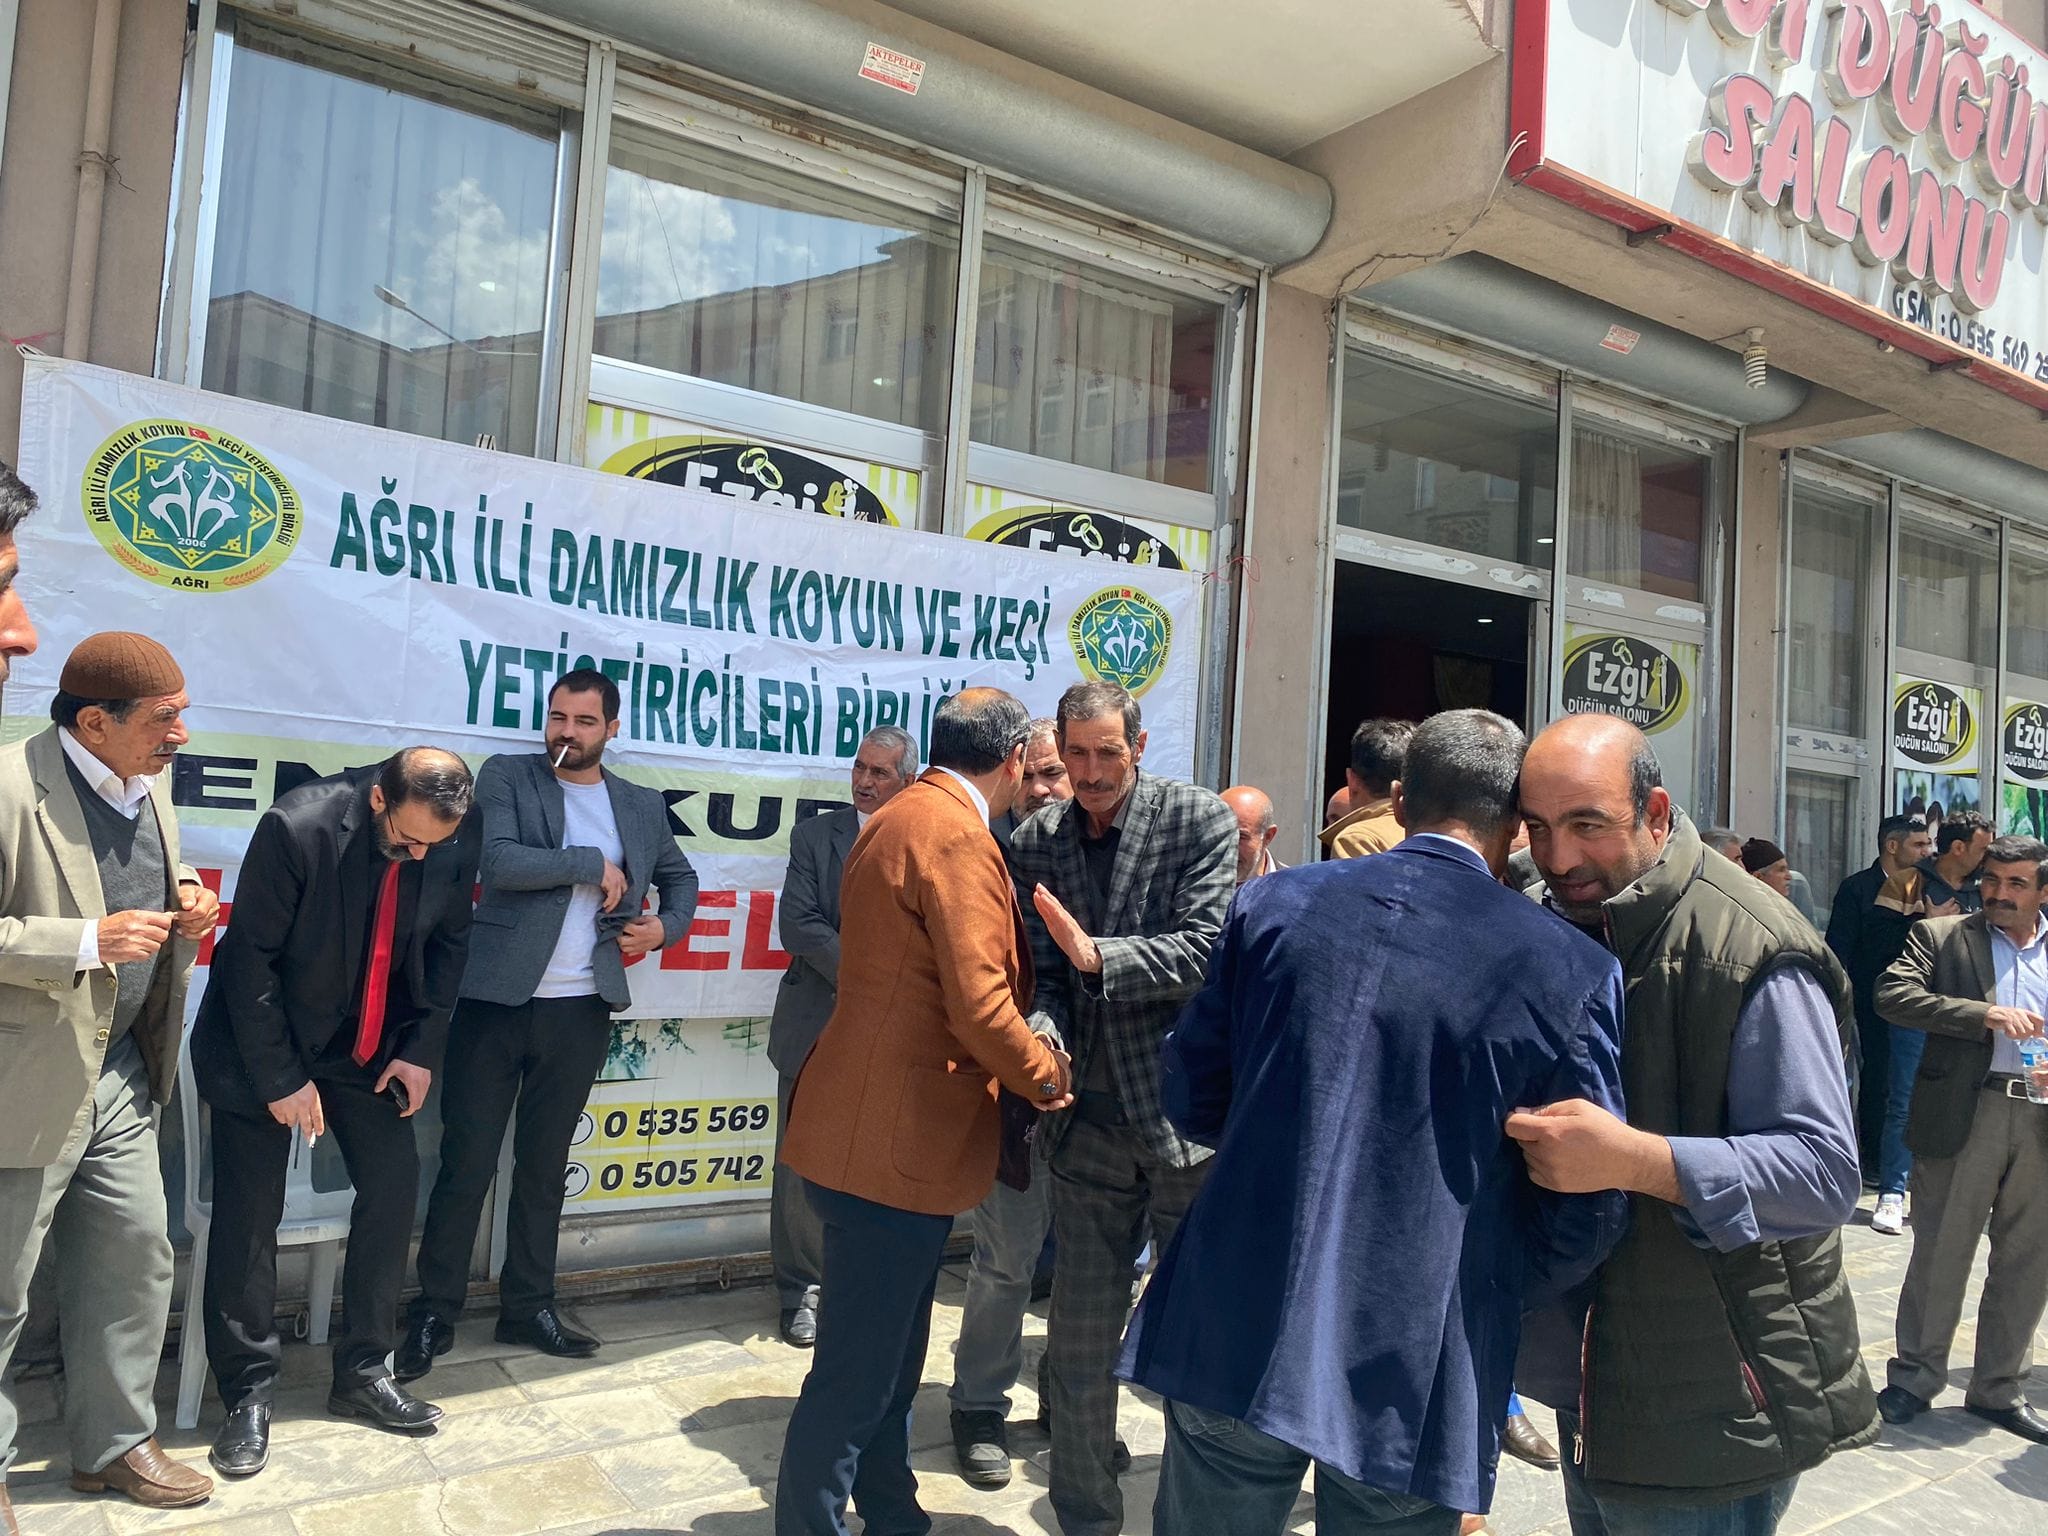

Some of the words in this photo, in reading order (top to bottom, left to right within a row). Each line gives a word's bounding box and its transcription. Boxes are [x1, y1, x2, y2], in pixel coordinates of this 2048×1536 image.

[869, 47, 922, 73] AKTEPELER
[1701, 73, 2010, 311] SALONU
[1892, 284, 1933, 333] GSM
[1966, 319, 1996, 358] 535
[2003, 335, 2029, 373] 569
[140, 425, 186, 440] KOYUN
[218, 436, 244, 454] KEÇİ
[94, 432, 141, 477] DAMIZLIK
[243, 450, 299, 511] YETİŞTİRİCİLERİ
[88, 497, 110, 522] AĞRI
[177, 537, 207, 548] 2006
[275, 512, 299, 547] BİRLİĞİ
[171, 574, 209, 589] AĞRI
[331, 476, 457, 586] AĞRI
[473, 494, 532, 598] İLİ
[549, 528, 759, 635] DAMIZLIK
[769, 567, 904, 652] KOYUN
[914, 585, 961, 659] VE
[969, 585, 1051, 682] KEÇİ
[460, 631, 820, 756] YETİRİCİLERİ
[1587, 651, 1649, 707] Ezgi
[1907, 695, 1949, 741] Ezgi
[1895, 733, 1921, 751] DÜĞÜN
[1921, 739, 1949, 755] SALONU
[604, 1111, 627, 1138] 0
[637, 1107, 699, 1137] 535
[707, 1104, 769, 1133] 569
[600, 1164, 623, 1191] 0
[632, 1159, 698, 1189] 505
[706, 1154, 764, 1184] 742
